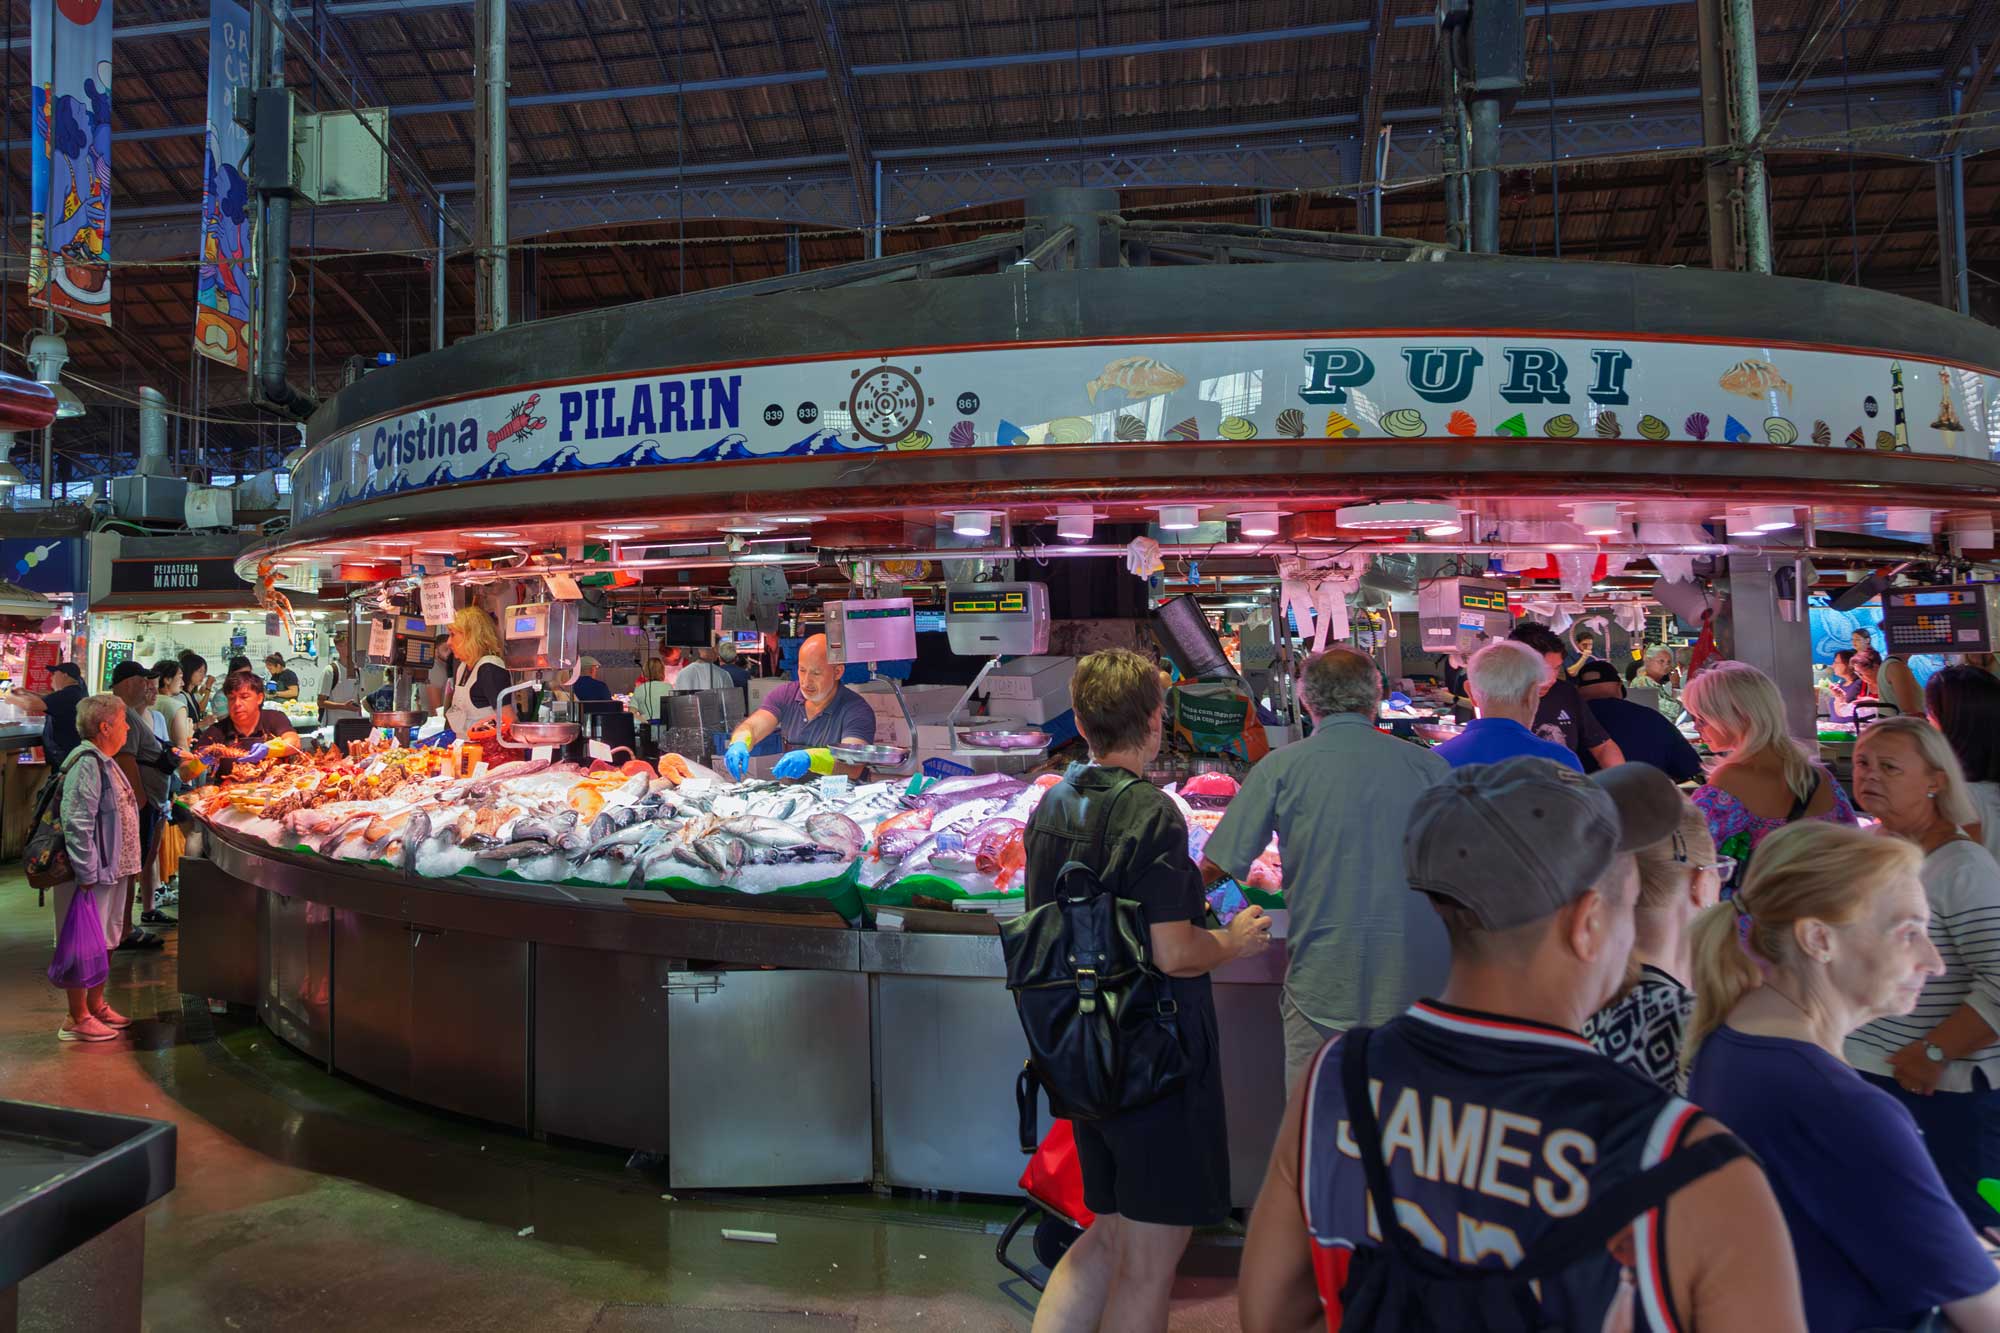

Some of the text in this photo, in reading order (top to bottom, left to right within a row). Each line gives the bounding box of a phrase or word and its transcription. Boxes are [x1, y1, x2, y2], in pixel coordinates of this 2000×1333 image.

[1298, 347, 1632, 405] PURI
[558, 375, 742, 441] PILARIN
[958, 397, 979, 410] 861
[764, 409, 784, 421] 839
[798, 406, 818, 419] 838
[373, 412, 478, 470] Cristina
[154, 564, 198, 574] PEIXATERIA
[153, 574, 198, 588] MANOLO
